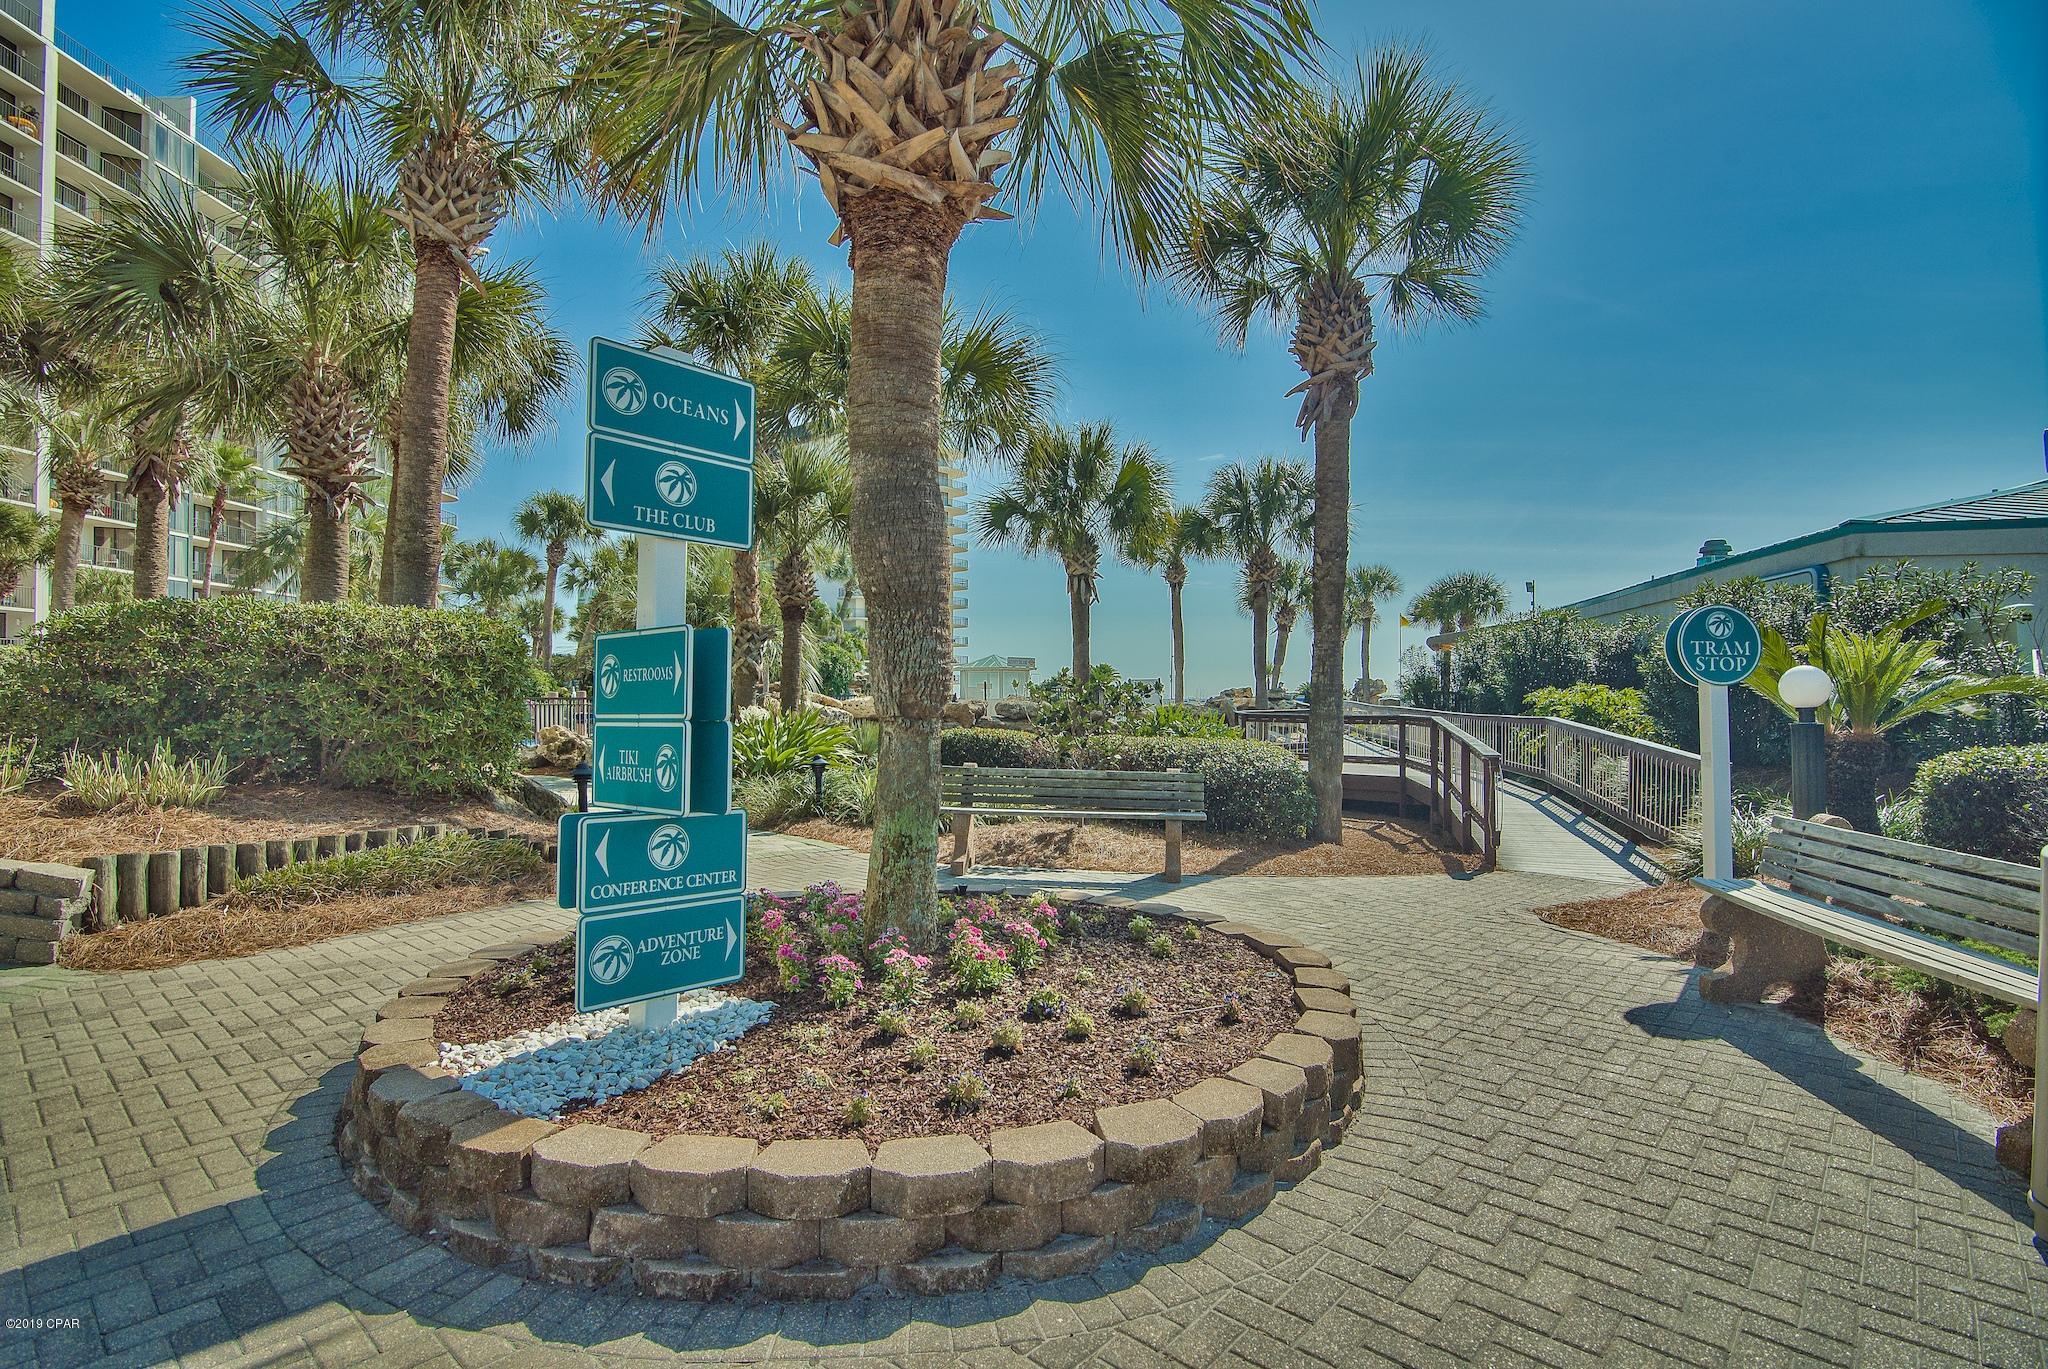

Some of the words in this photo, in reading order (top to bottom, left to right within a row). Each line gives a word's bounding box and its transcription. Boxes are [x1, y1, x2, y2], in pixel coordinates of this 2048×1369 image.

[653, 392, 728, 426] OCEANS
[633, 506, 669, 526] THE
[673, 513, 716, 533] CLUB
[1691, 641, 1750, 656] TRAM
[1696, 656, 1746, 671] STOP
[624, 666, 673, 682] RESTROOMS
[619, 750, 639, 765] TIKI
[606, 767, 652, 783] AIRBRUSH
[591, 876, 683, 900] CONFERENCE
[686, 870, 737, 886] CENTER
[636, 927, 724, 954] ADVENTURE
[661, 946, 701, 966] ZONE
